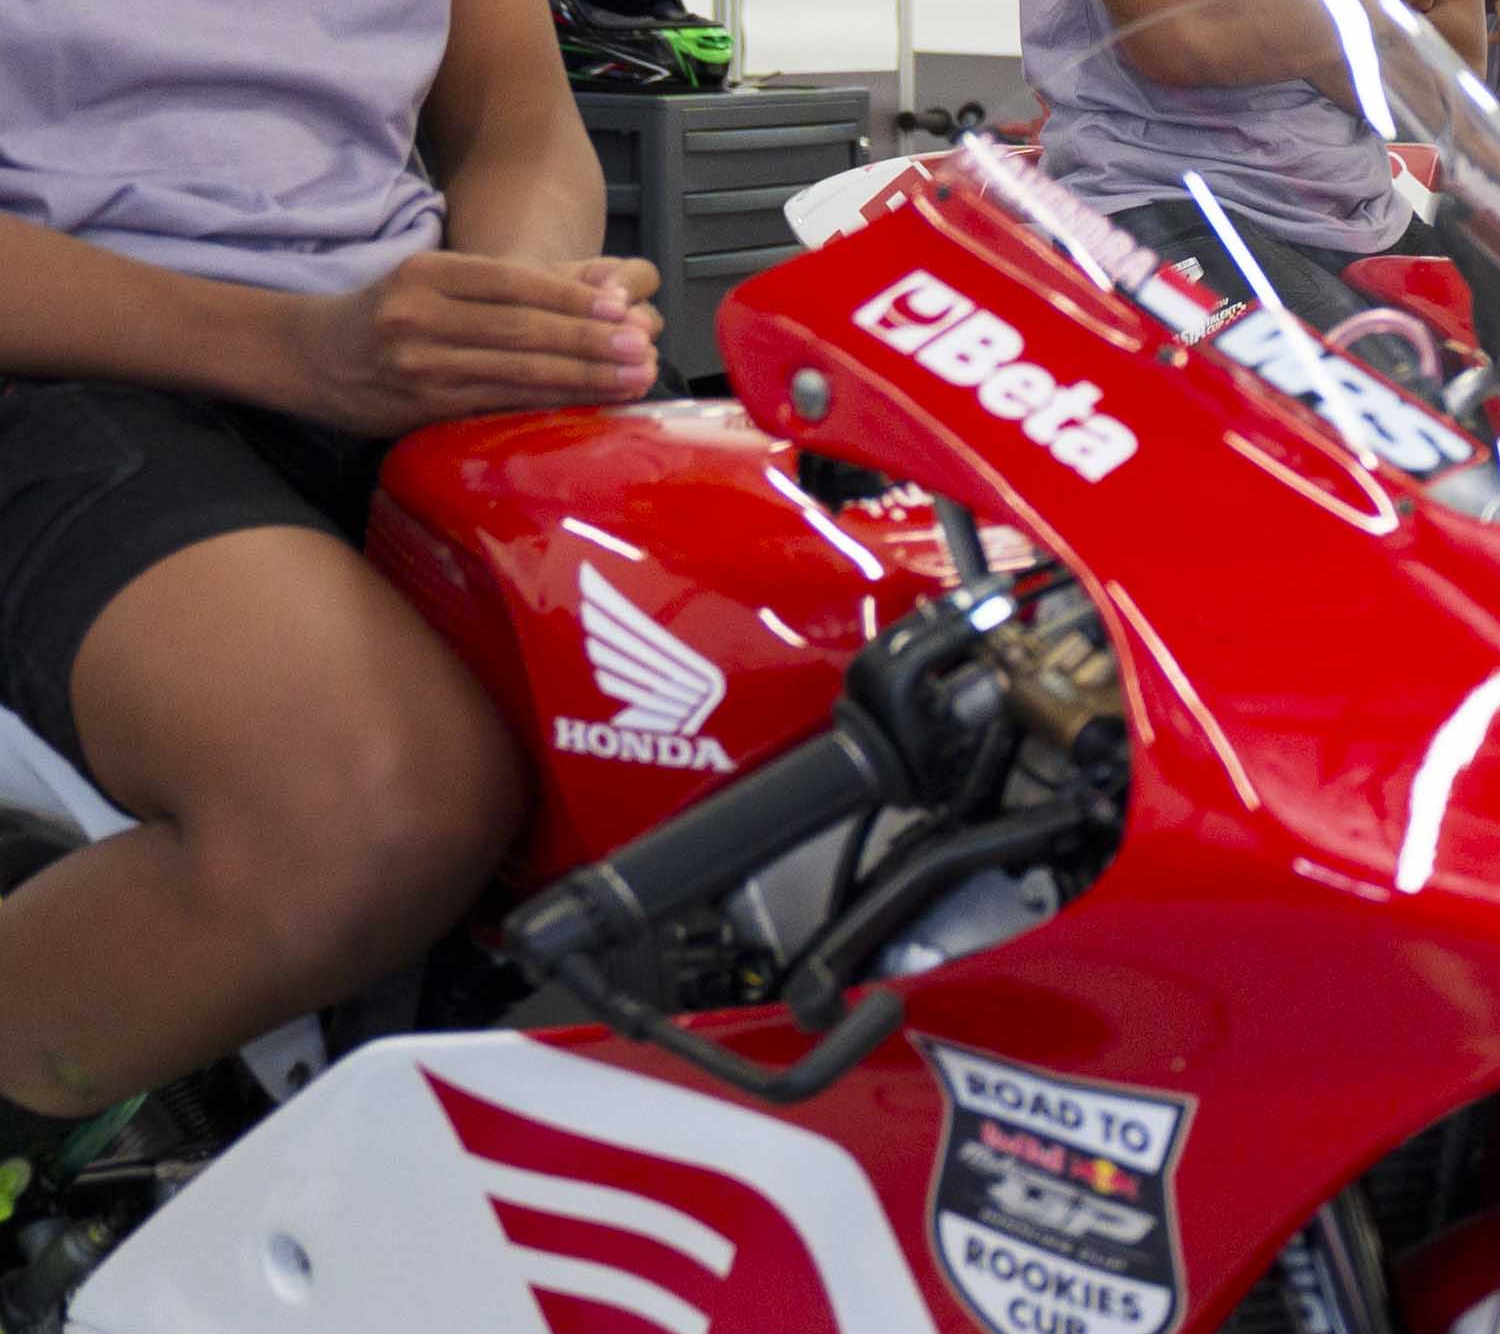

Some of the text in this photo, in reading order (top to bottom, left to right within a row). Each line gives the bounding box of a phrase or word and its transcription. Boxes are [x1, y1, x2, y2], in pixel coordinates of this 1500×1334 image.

[916, 295, 1138, 483] Beta
[1215, 312, 1477, 471] WRS
[555, 717, 737, 773] HONDA
[964, 1069, 1151, 1157] ROAD TO
[963, 1232, 1143, 1323] ROOKIES
